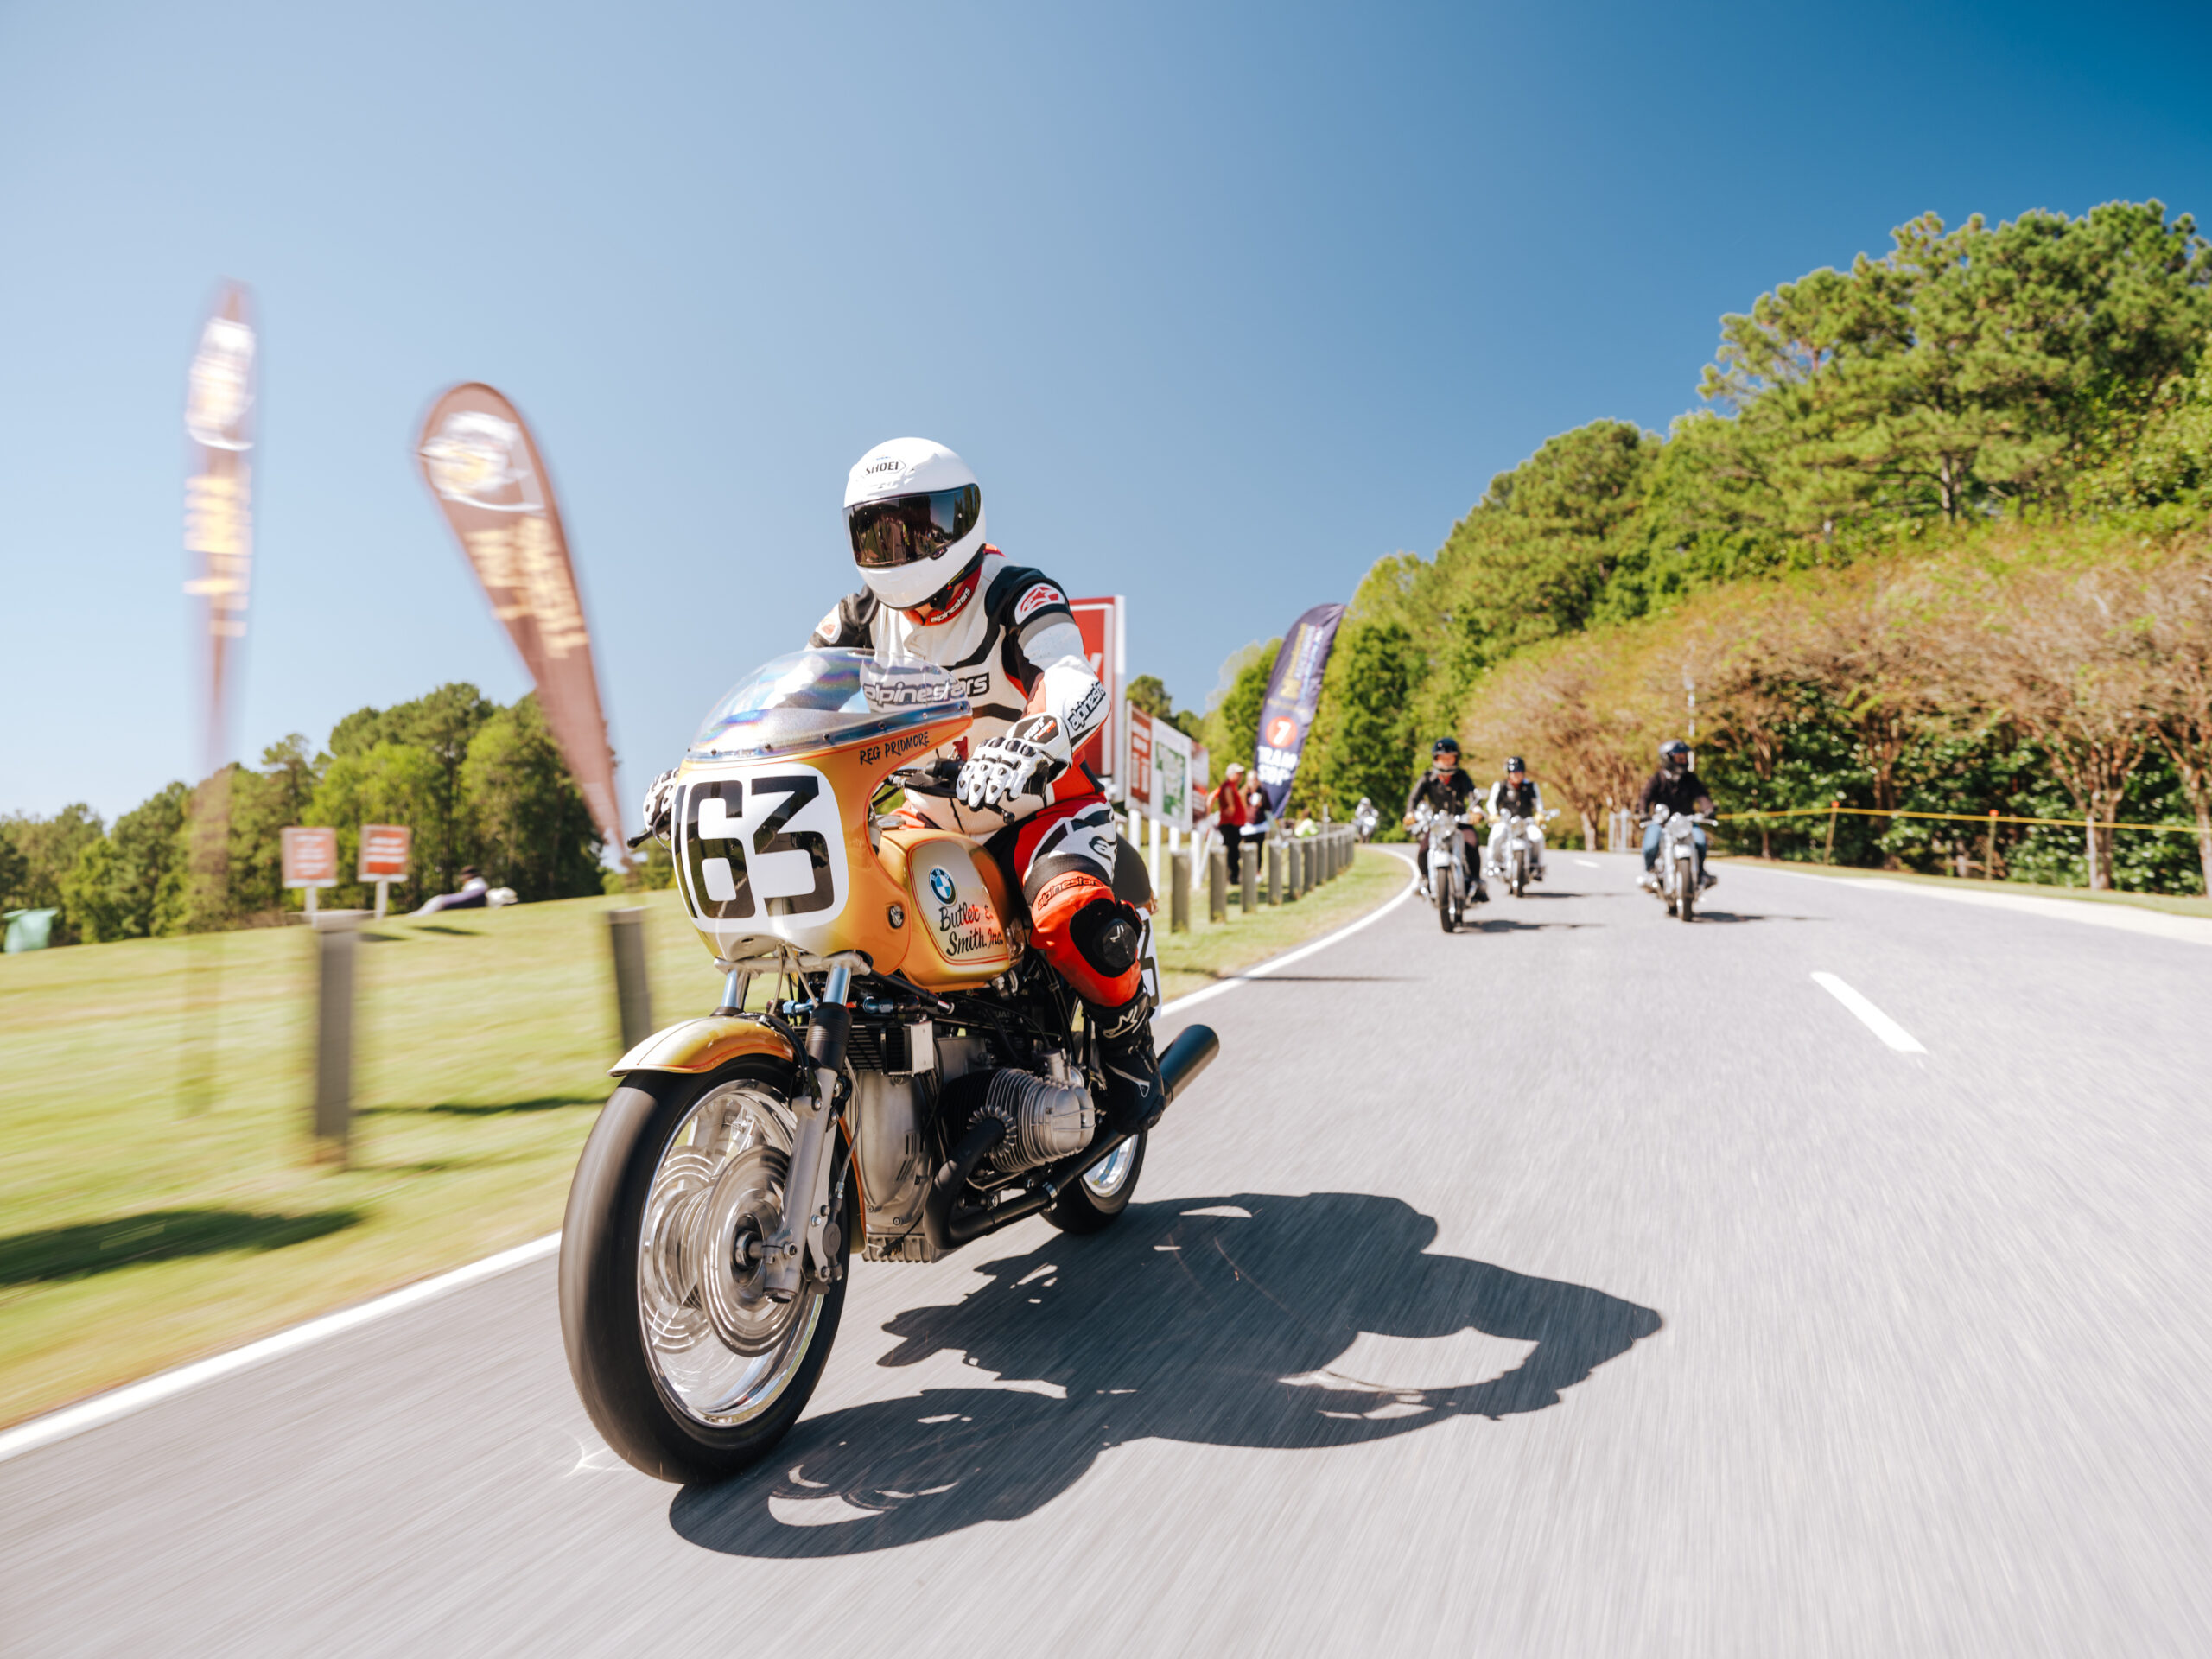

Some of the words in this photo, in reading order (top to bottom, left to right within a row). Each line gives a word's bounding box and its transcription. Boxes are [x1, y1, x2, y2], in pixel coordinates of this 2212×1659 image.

[865, 461, 899, 476] SHOEI
[930, 587, 971, 623] alpinestars
[862, 672, 990, 708] alpinestars
[859, 747, 881, 766] REG
[884, 731, 931, 759] PRIDMORE
[938, 901, 981, 932] Butler
[984, 904, 994, 920] &
